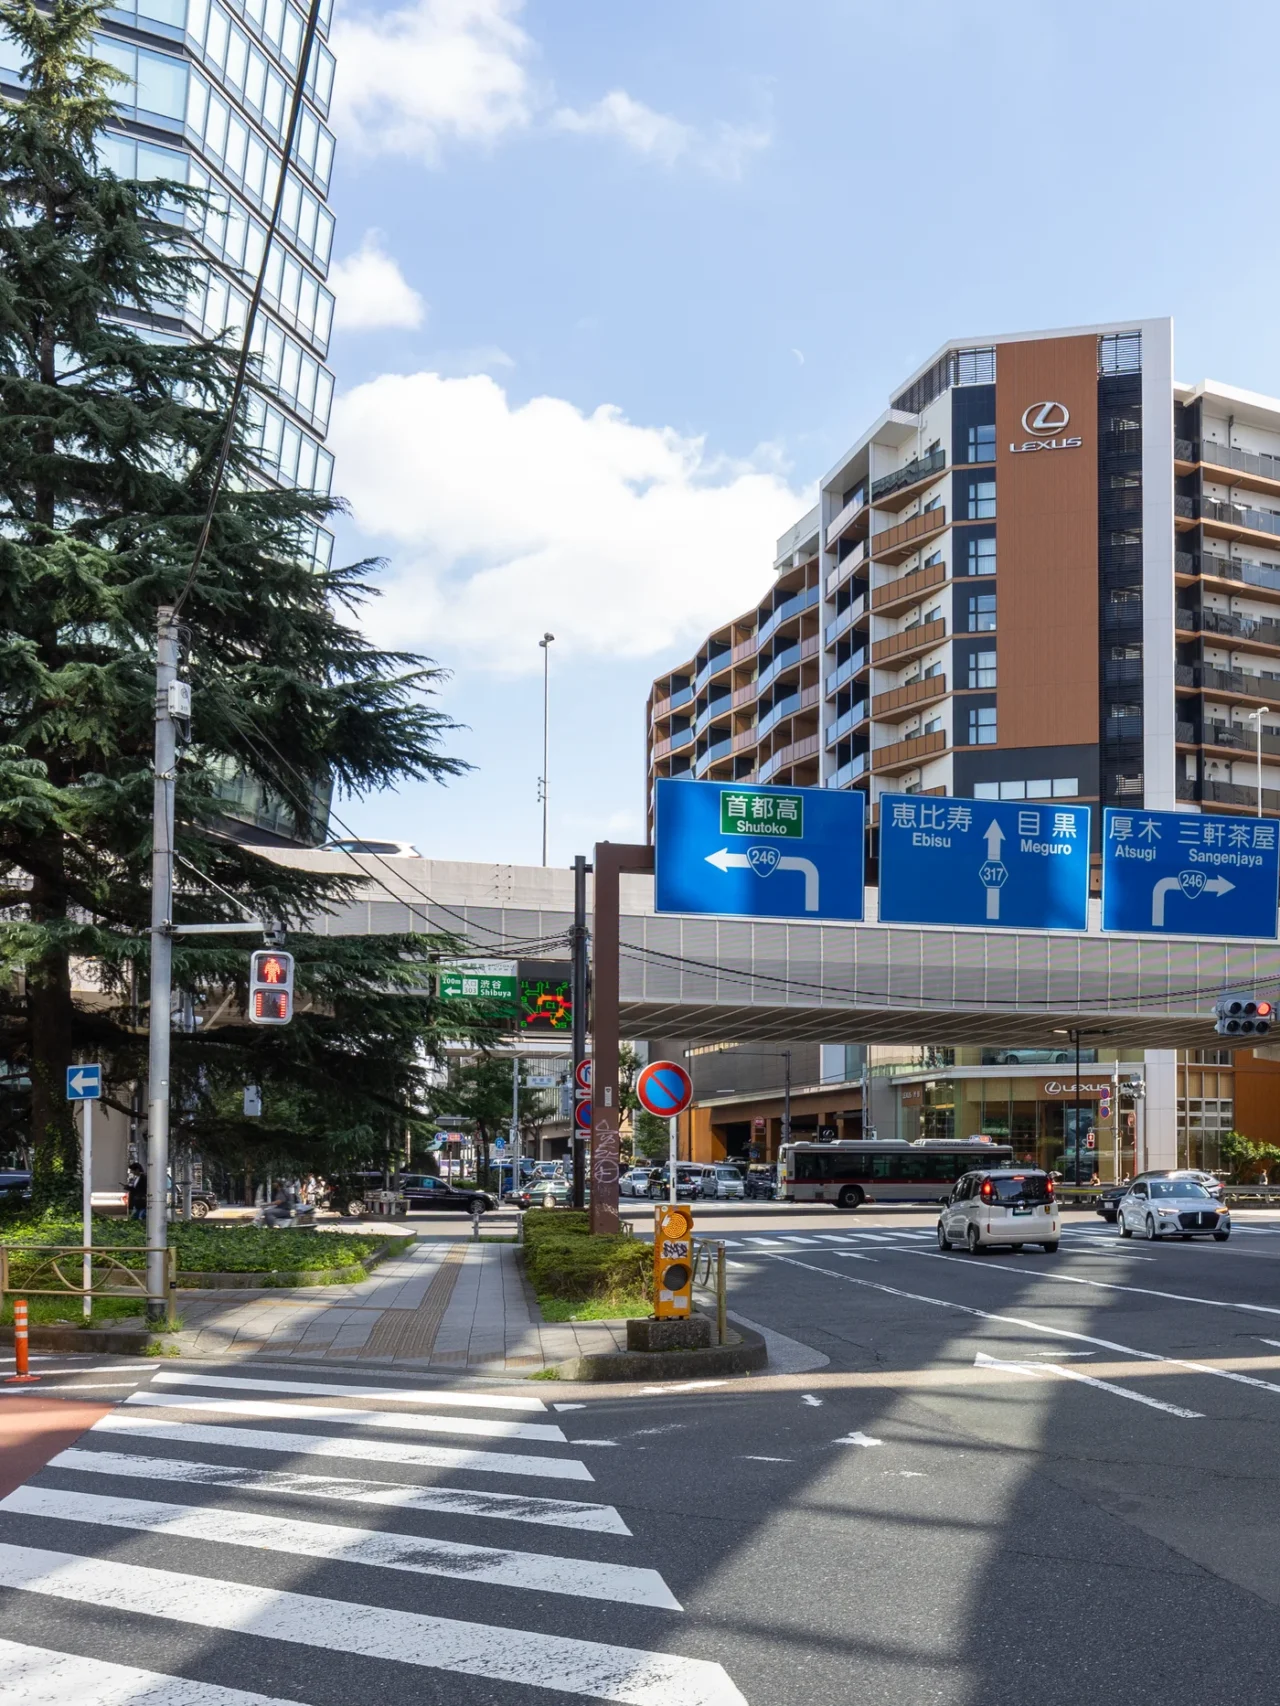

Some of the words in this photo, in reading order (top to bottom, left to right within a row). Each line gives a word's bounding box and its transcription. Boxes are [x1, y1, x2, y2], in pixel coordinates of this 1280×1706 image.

[1009, 436, 1082, 453] LEXUS
[726, 795, 798, 820] 首都高
[891, 802, 973, 833] 恵比寿
[1018, 810, 1077, 839] 目黒
[736, 820, 787, 835] Shutoko
[1109, 816, 1162, 842] 厚木
[1177, 821, 1275, 850] 三軒茶屋
[912, 832, 951, 848] Ebisu
[1020, 839, 1072, 856] Meguro
[751, 850, 775, 865] 246
[1115, 845, 1156, 861] Atsugi
[1189, 848, 1263, 867] Sangenjaya
[983, 867, 1004, 881] 317
[1182, 874, 1203, 888] 246
[480, 980, 502, 989] 渋谷
[480, 989, 512, 998] Shibuya
[1063, 1084, 1110, 1092] LEXUS
